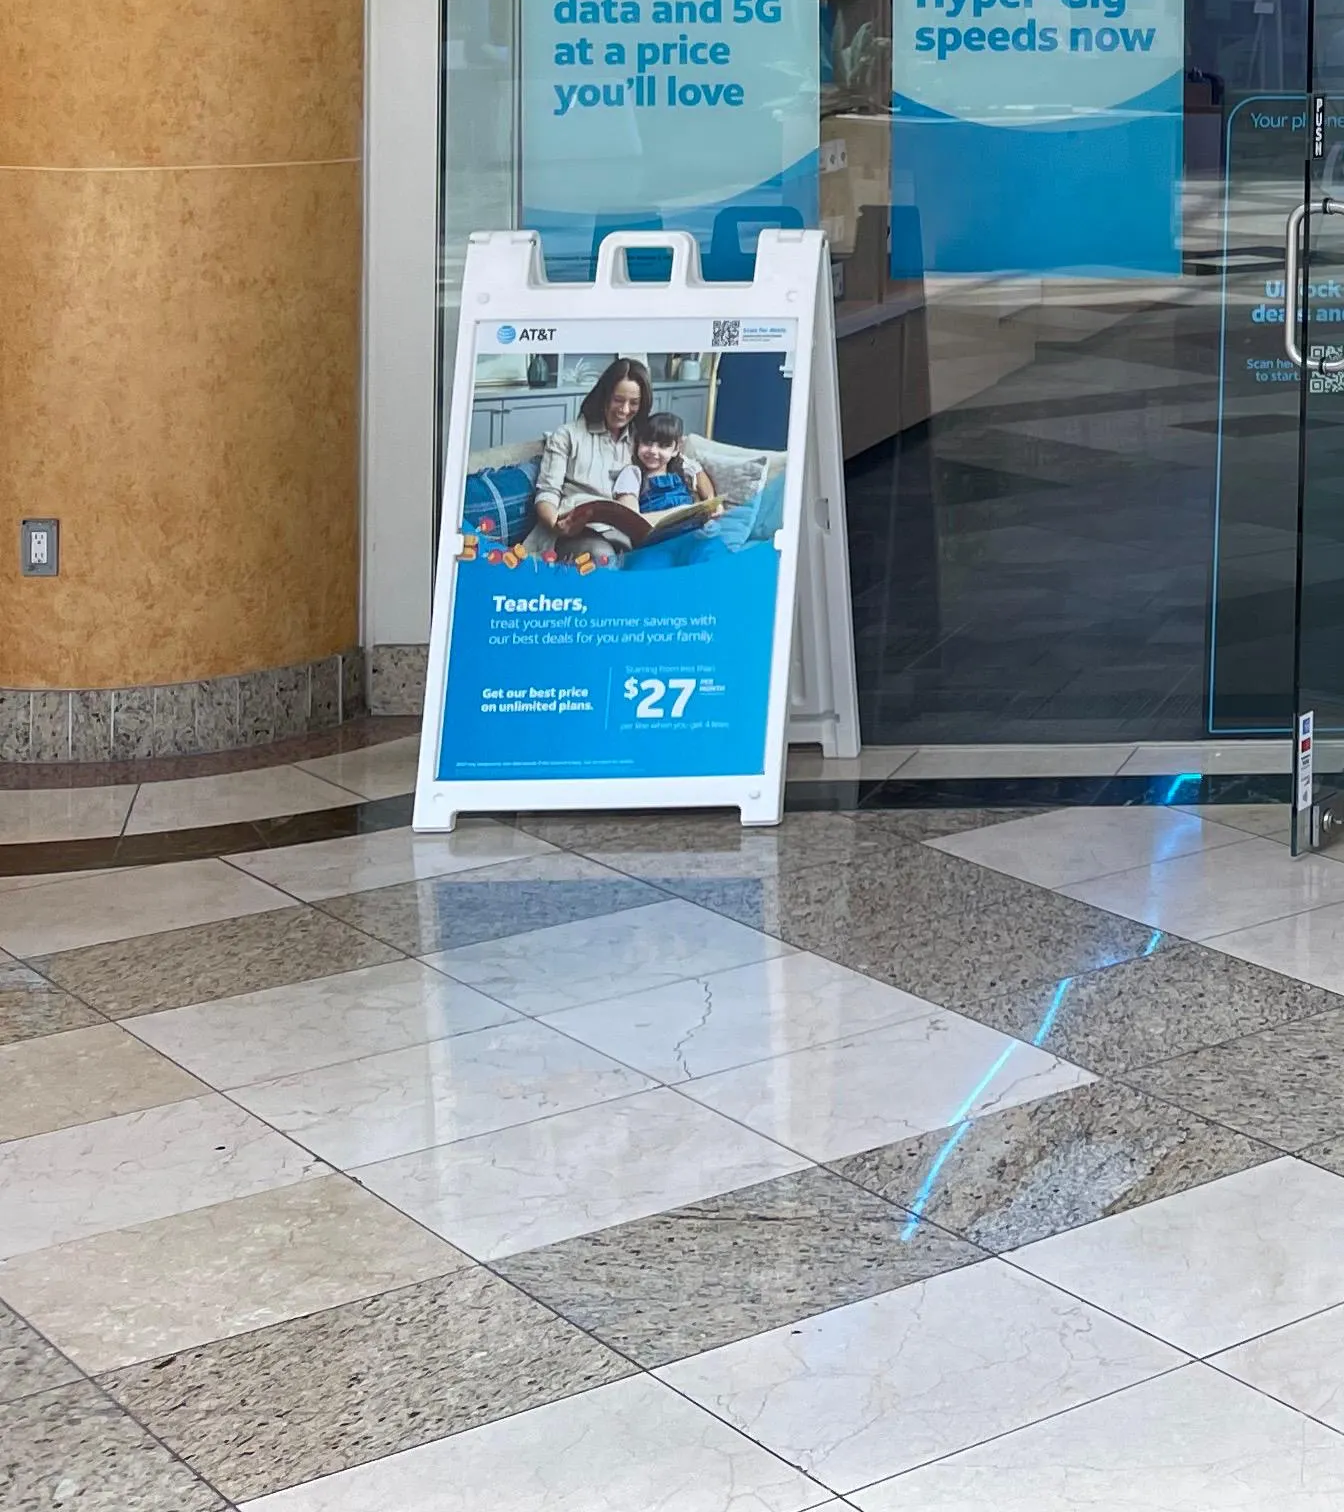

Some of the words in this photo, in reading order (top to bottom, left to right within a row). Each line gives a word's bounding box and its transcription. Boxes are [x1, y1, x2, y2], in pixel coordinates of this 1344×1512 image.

[915, 18, 1059, 60] speeds
[1069, 26, 1156, 52] now
[554, 37, 594, 65] at
[604, 41, 626, 65] a
[637, 34, 731, 73] price
[553, 75, 656, 116] you'll
[667, 75, 745, 107] love
[1250, 112, 1288, 128] Your
[1315, 98, 1324, 157] PUSH
[1265, 280, 1342, 298] Uock
[1252, 304, 1311, 322] deas
[519, 328, 557, 342] AT&T
[1247, 358, 1274, 370] Scan
[1255, 370, 1268, 382] to
[492, 593, 588, 615] Teachers,
[490, 617, 520, 629] treat
[523, 616, 573, 632] yourself
[574, 617, 588, 628] to
[590, 617, 640, 628] summer
[642, 615, 688, 631] savings
[690, 614, 717, 626] with
[488, 634, 510, 645] our
[512, 633, 539, 645] best
[541, 632, 574, 644] deals
[576, 632, 593, 644] for
[595, 633, 619, 647] you
[620, 631, 645, 643] and
[647, 632, 674, 646] your
[676, 629, 714, 645] family.
[482, 687, 504, 699] Get
[506, 690, 526, 699] our
[529, 686, 556, 699] best
[558, 686, 589, 701] price
[624, 676, 697, 719] $27
[480, 703, 497, 713] on
[499, 700, 557, 713] unlimited
[558, 700, 594, 714] plans.
